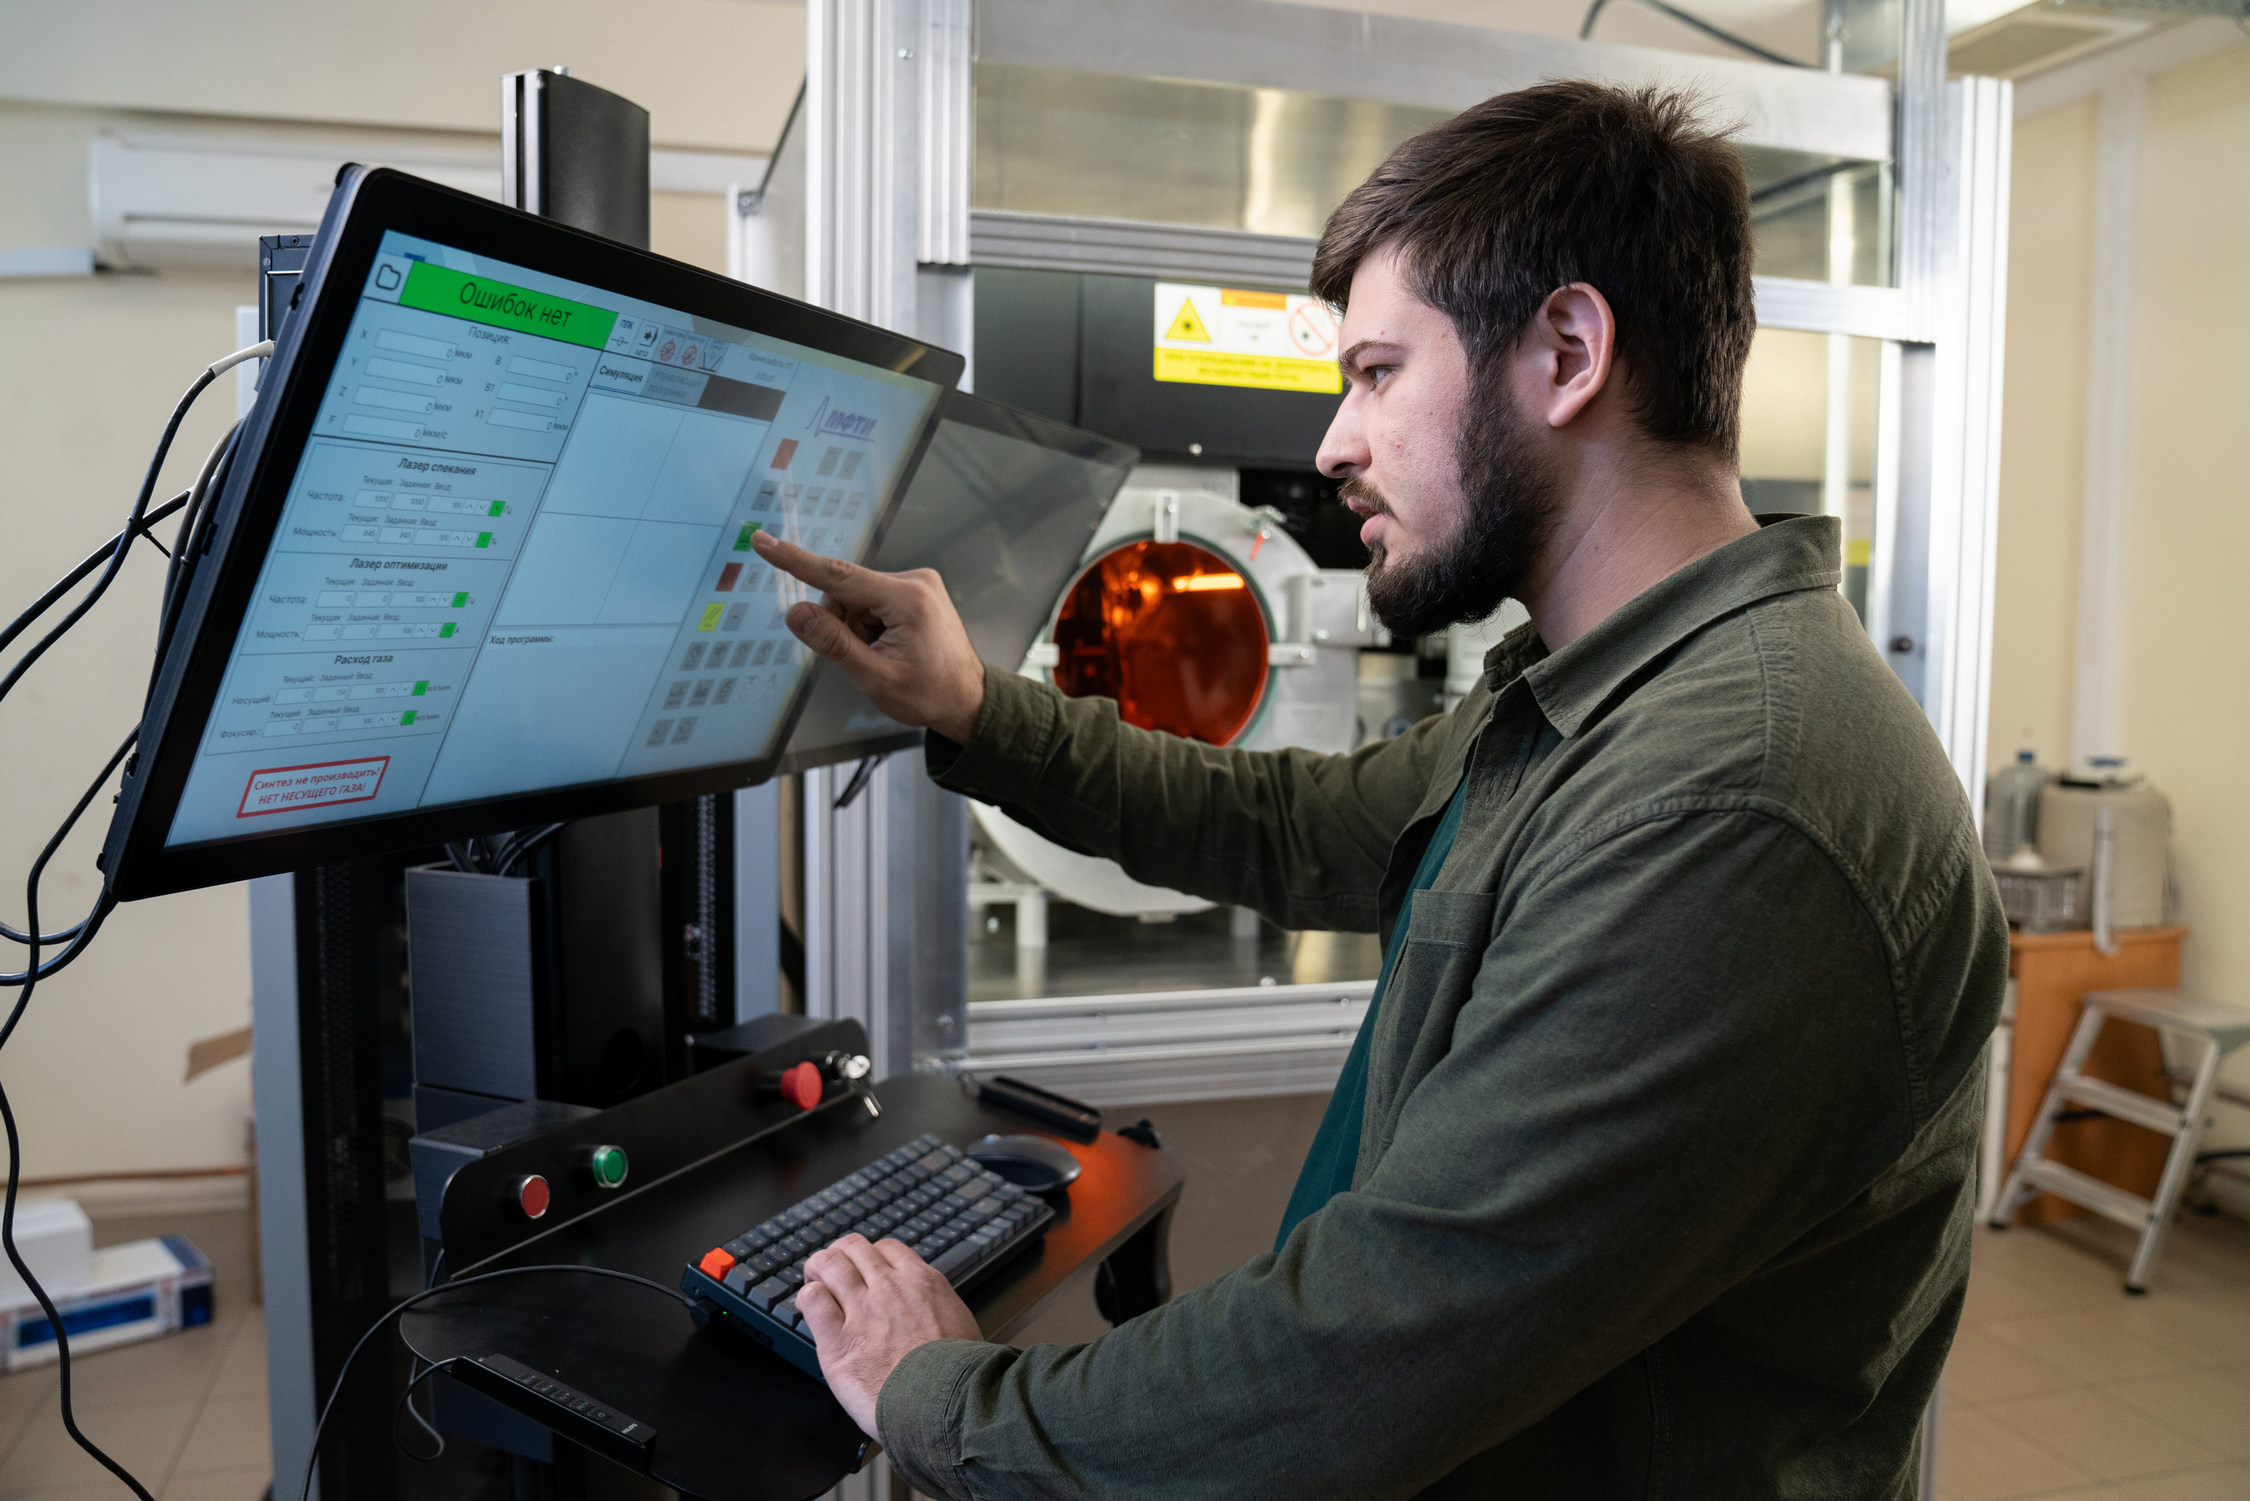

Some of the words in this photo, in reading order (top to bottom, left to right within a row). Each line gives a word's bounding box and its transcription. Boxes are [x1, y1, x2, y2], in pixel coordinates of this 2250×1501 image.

[459, 282, 534, 321] Ошибок
[540, 307, 573, 328] нет
[467, 325, 512, 345] Позиция:
[446, 348, 453, 359] 0
[436, 374, 444, 385] 0
[599, 365, 644, 384] Симуляция
[425, 401, 433, 412] 0
[414, 428, 422, 439] 0
[397, 457, 430, 475] Лазер
[430, 463, 477, 476] спекания
[307, 489, 347, 502] Частота:
[293, 527, 340, 538] Мощность:
[349, 557, 382, 571] Лазер
[383, 560, 448, 572] оптимизации
[268, 595, 308, 605] Частота:
[255, 630, 302, 640] Мощность:
[488, 635, 506, 646] Ход
[506, 635, 555, 646] программы:
[334, 654, 370, 666] Расход
[372, 653, 393, 664] газа
[232, 695, 274, 706] Несущий:
[254, 778, 293, 791] Синтез
[295, 776, 308, 785] не
[310, 766, 381, 786] производить!
[258, 793, 280, 805] НЕТ
[280, 786, 338, 803] НЕСУЩЕГО
[338, 782, 367, 794] ГАЗА!
